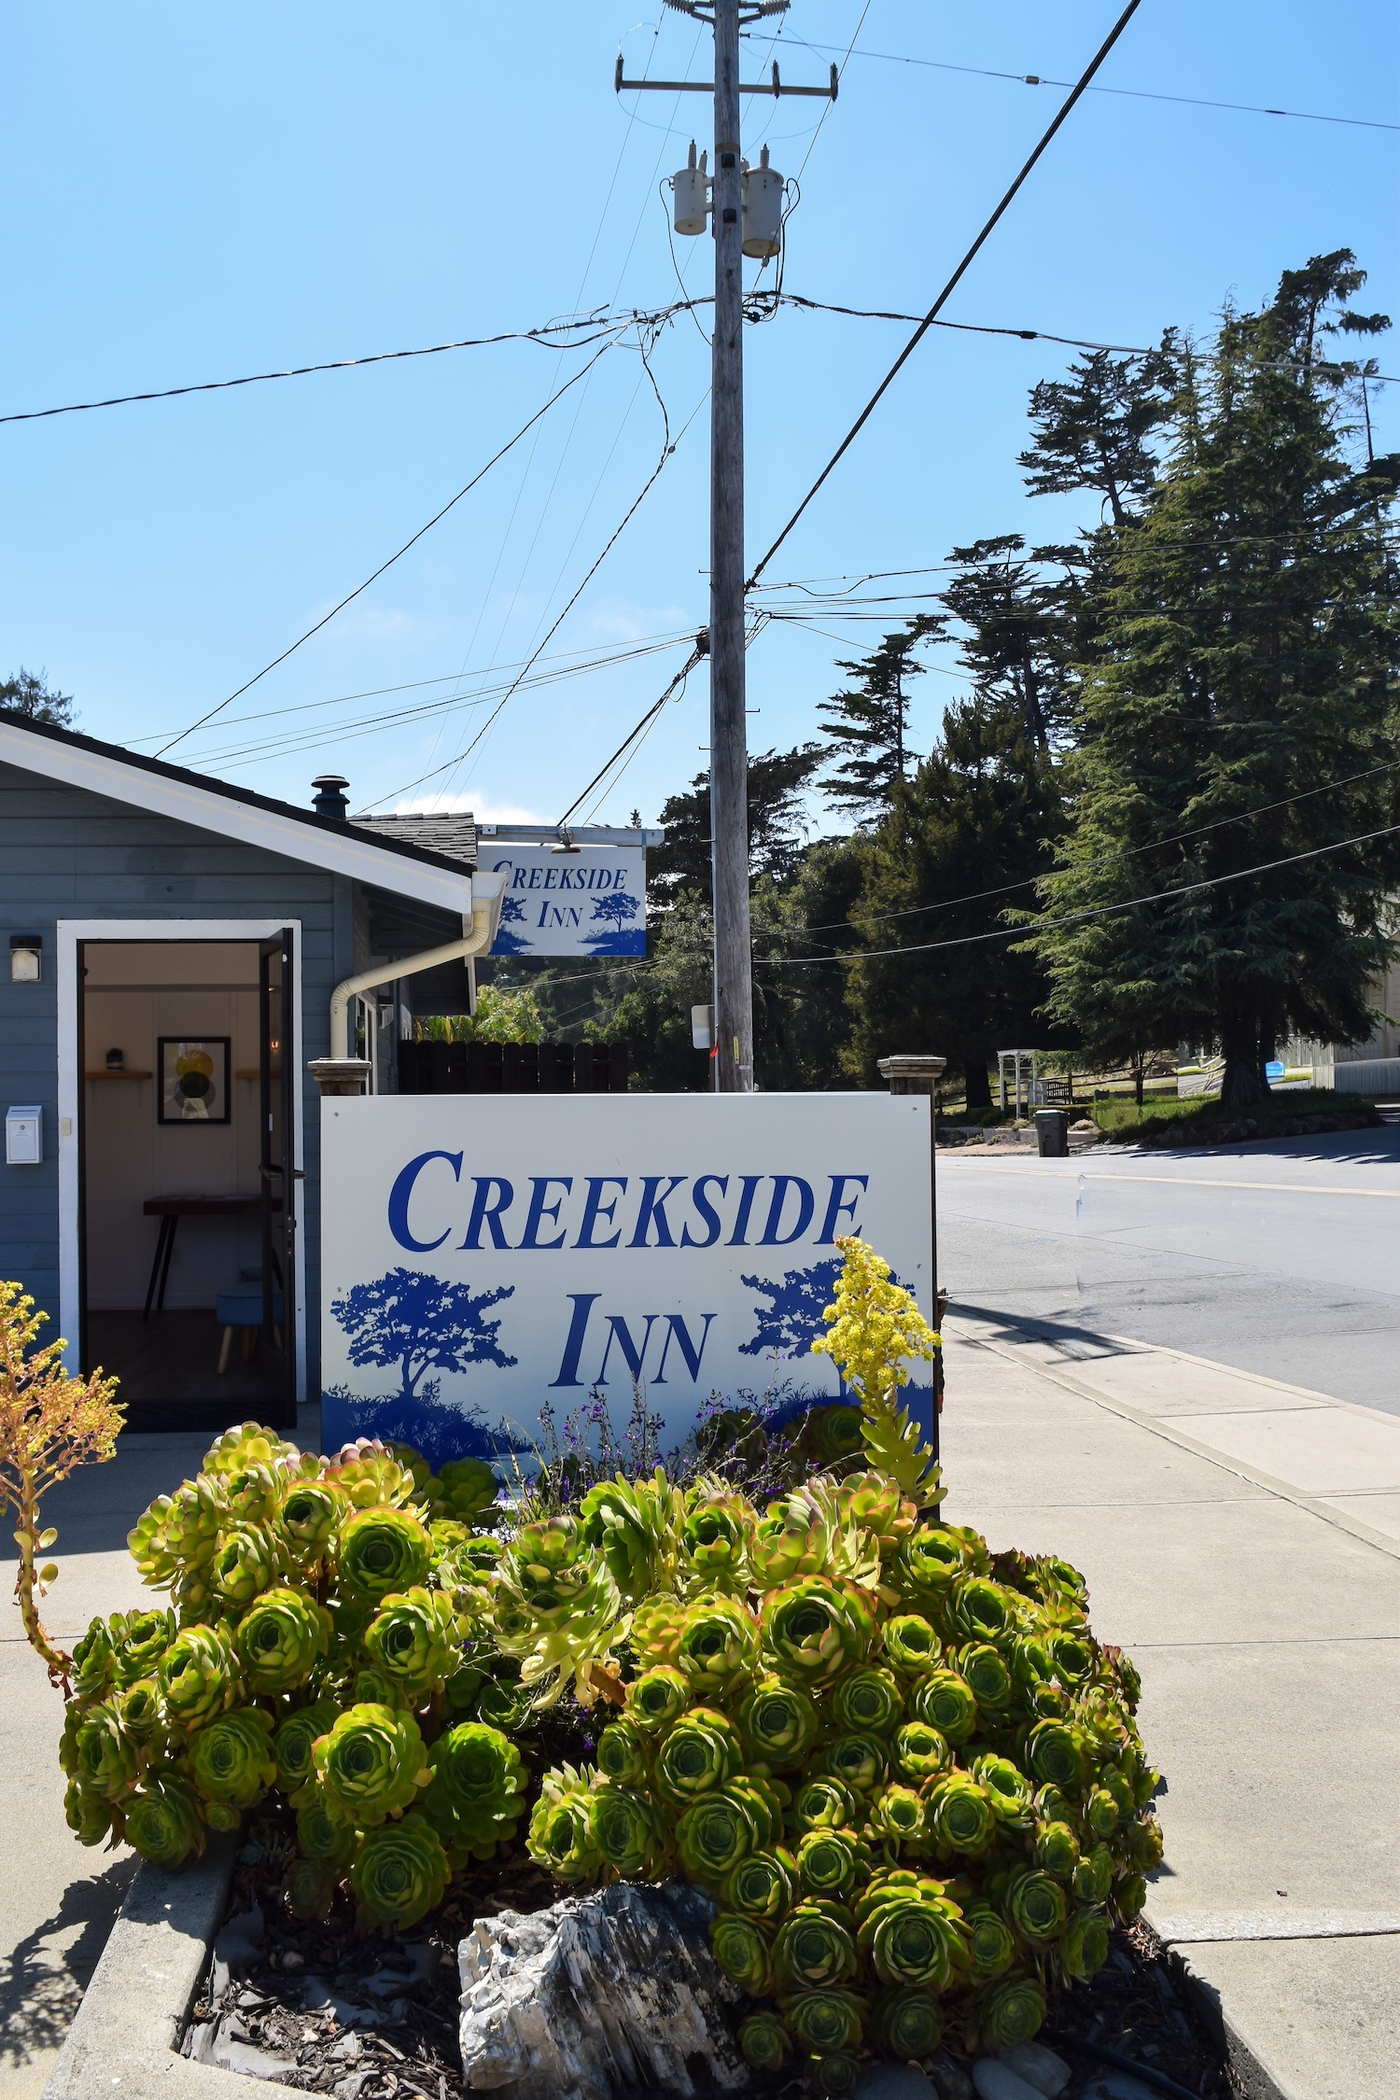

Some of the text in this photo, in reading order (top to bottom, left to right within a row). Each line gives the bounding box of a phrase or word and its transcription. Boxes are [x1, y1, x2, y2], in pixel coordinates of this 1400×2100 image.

[536, 900, 584, 928] INN
[388, 1150, 869, 1253] CREEKSIDE
[548, 1293, 718, 1388] INN
